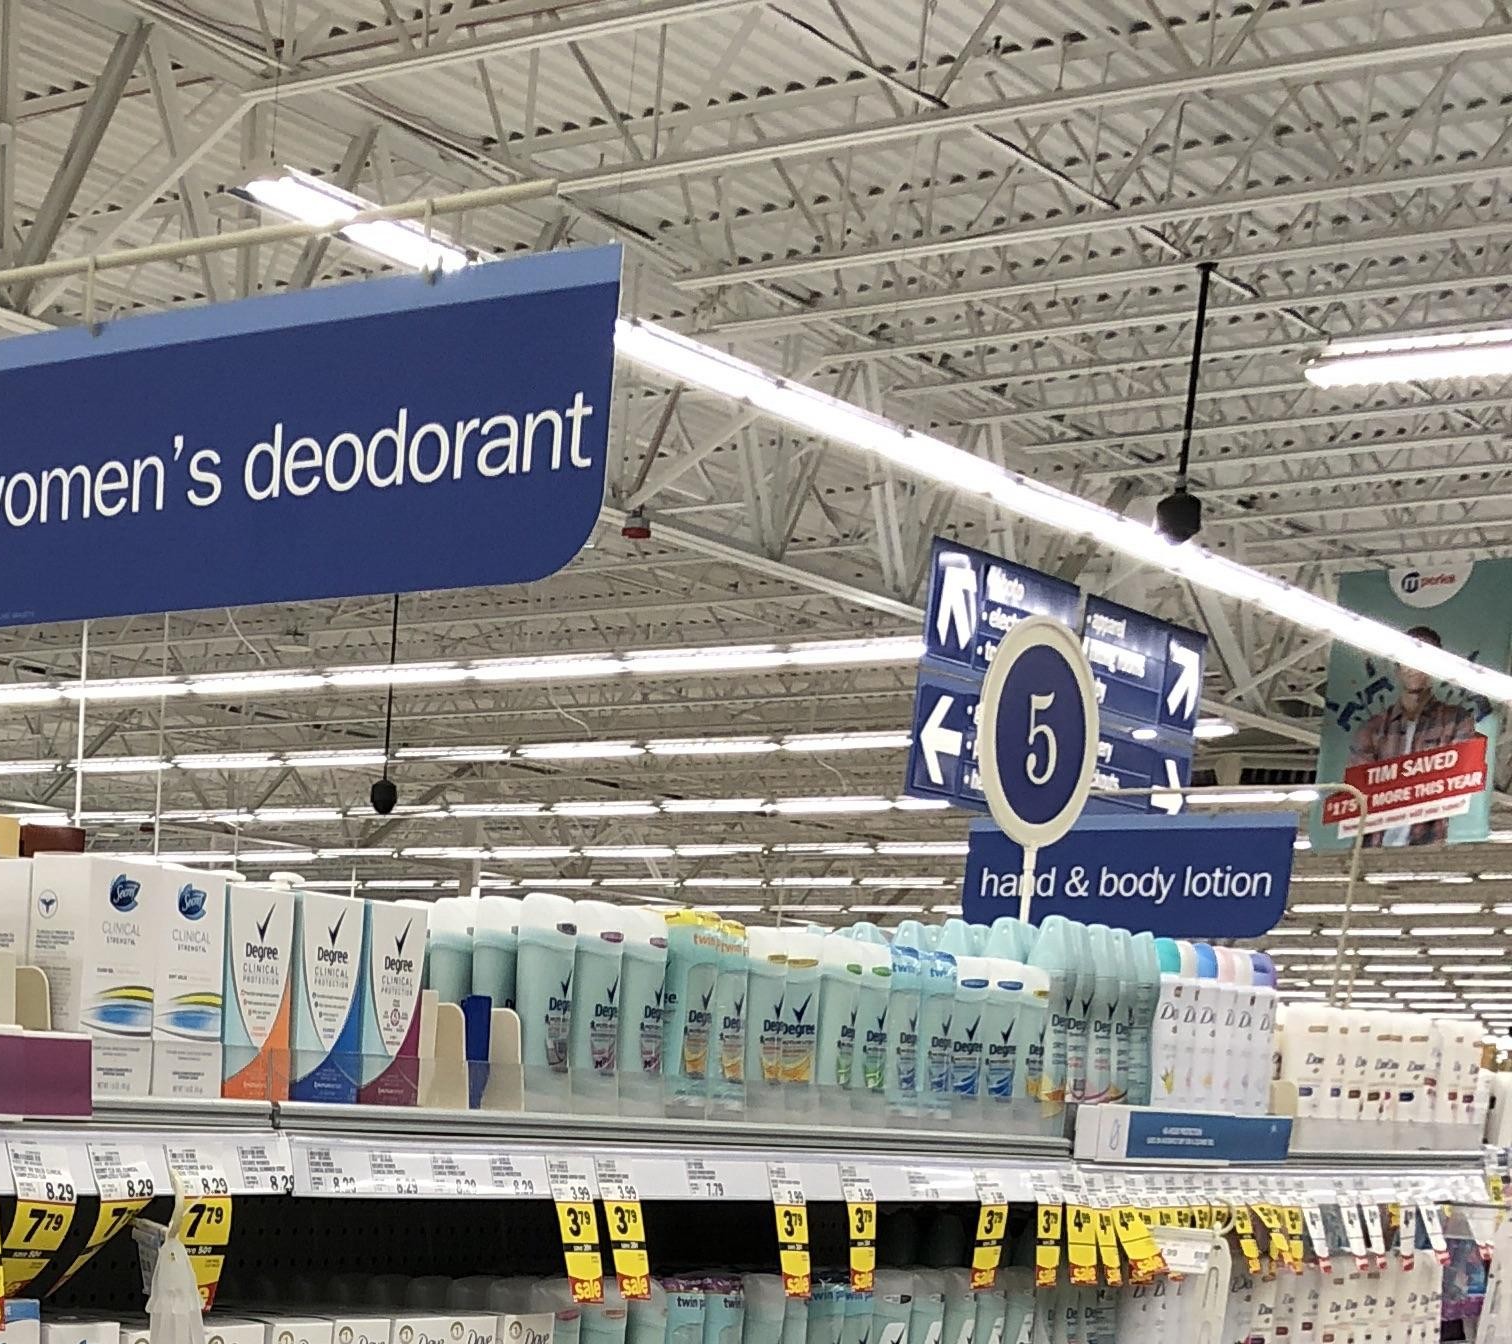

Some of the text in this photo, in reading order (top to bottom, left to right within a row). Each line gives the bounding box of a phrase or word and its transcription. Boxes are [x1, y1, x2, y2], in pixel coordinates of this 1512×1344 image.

[244, 392, 593, 500] deodorant
[1026, 691, 1057, 785] 5
[1366, 750, 1458, 786] TIM SAVED
[1371, 790, 1411, 808] MORE
[1413, 782, 1445, 800] THIS
[1447, 770, 1483, 792] YEAR
[1065, 866, 1089, 897] &
[1099, 866, 1175, 904] body
[1183, 866, 1271, 897] lotion
[245, 942, 279, 962] Degree
[316, 946, 349, 965] Degree
